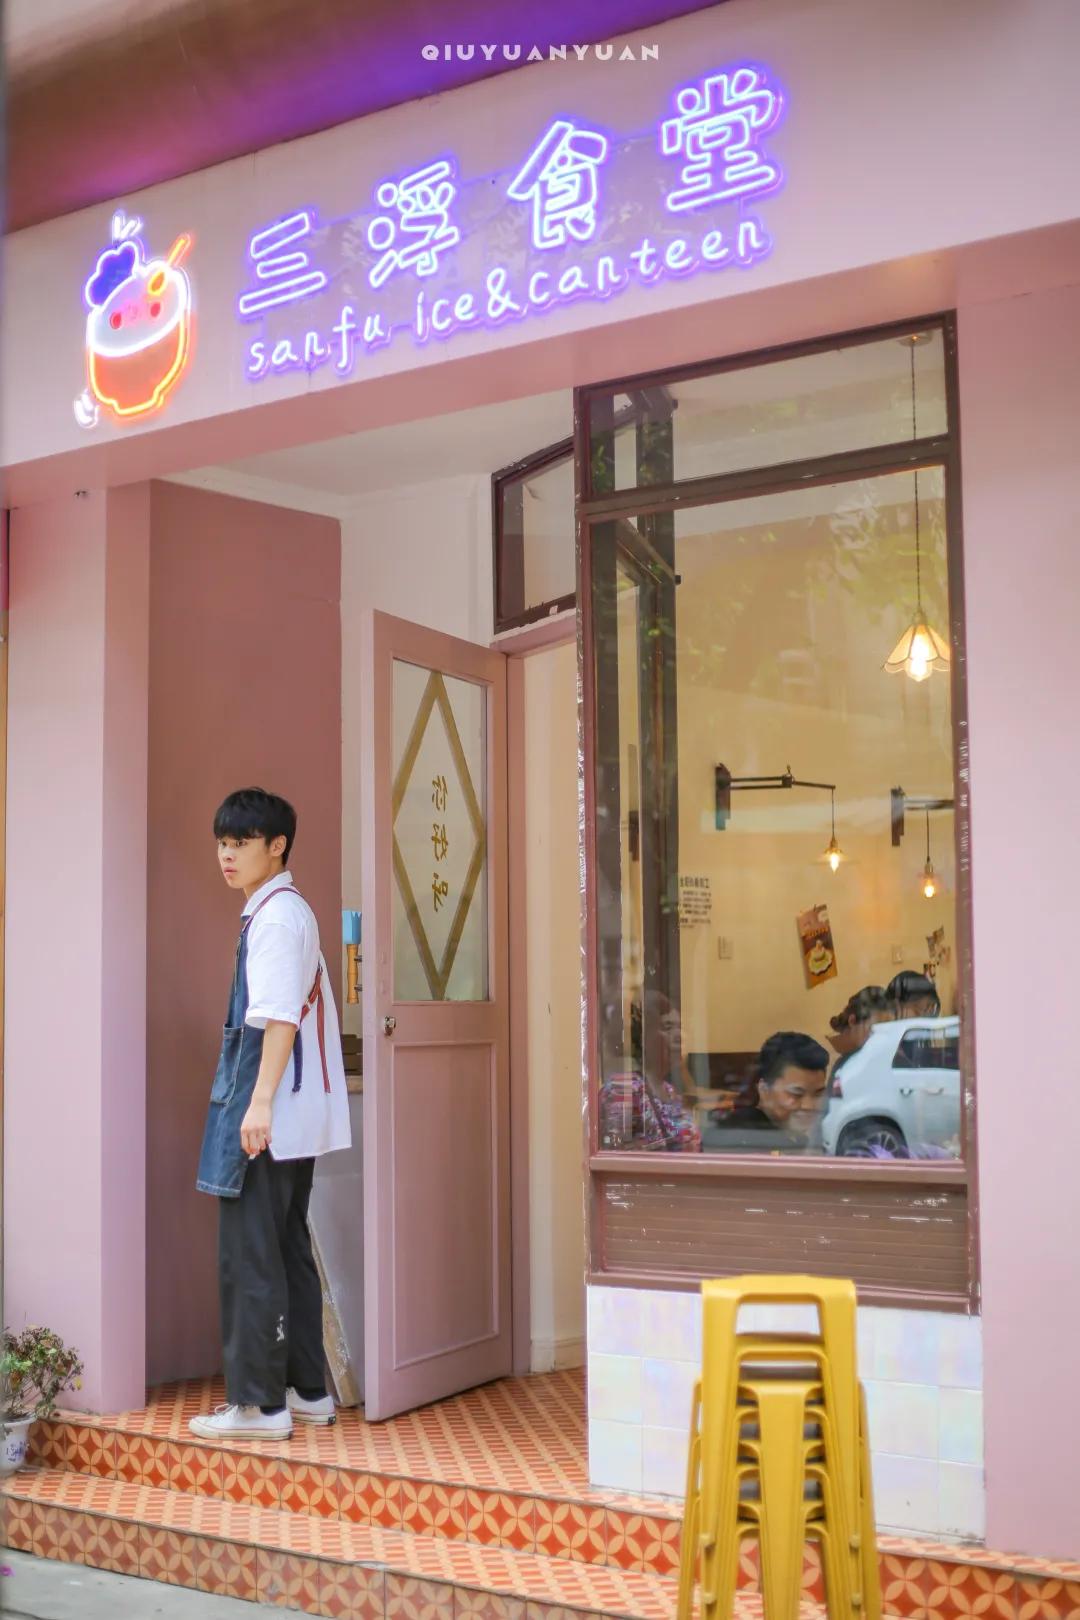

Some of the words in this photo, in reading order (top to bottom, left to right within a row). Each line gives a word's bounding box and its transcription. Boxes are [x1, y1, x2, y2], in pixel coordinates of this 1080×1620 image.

[239, 67, 777, 315] 三浮食堂
[248, 305, 386, 372] sanfu
